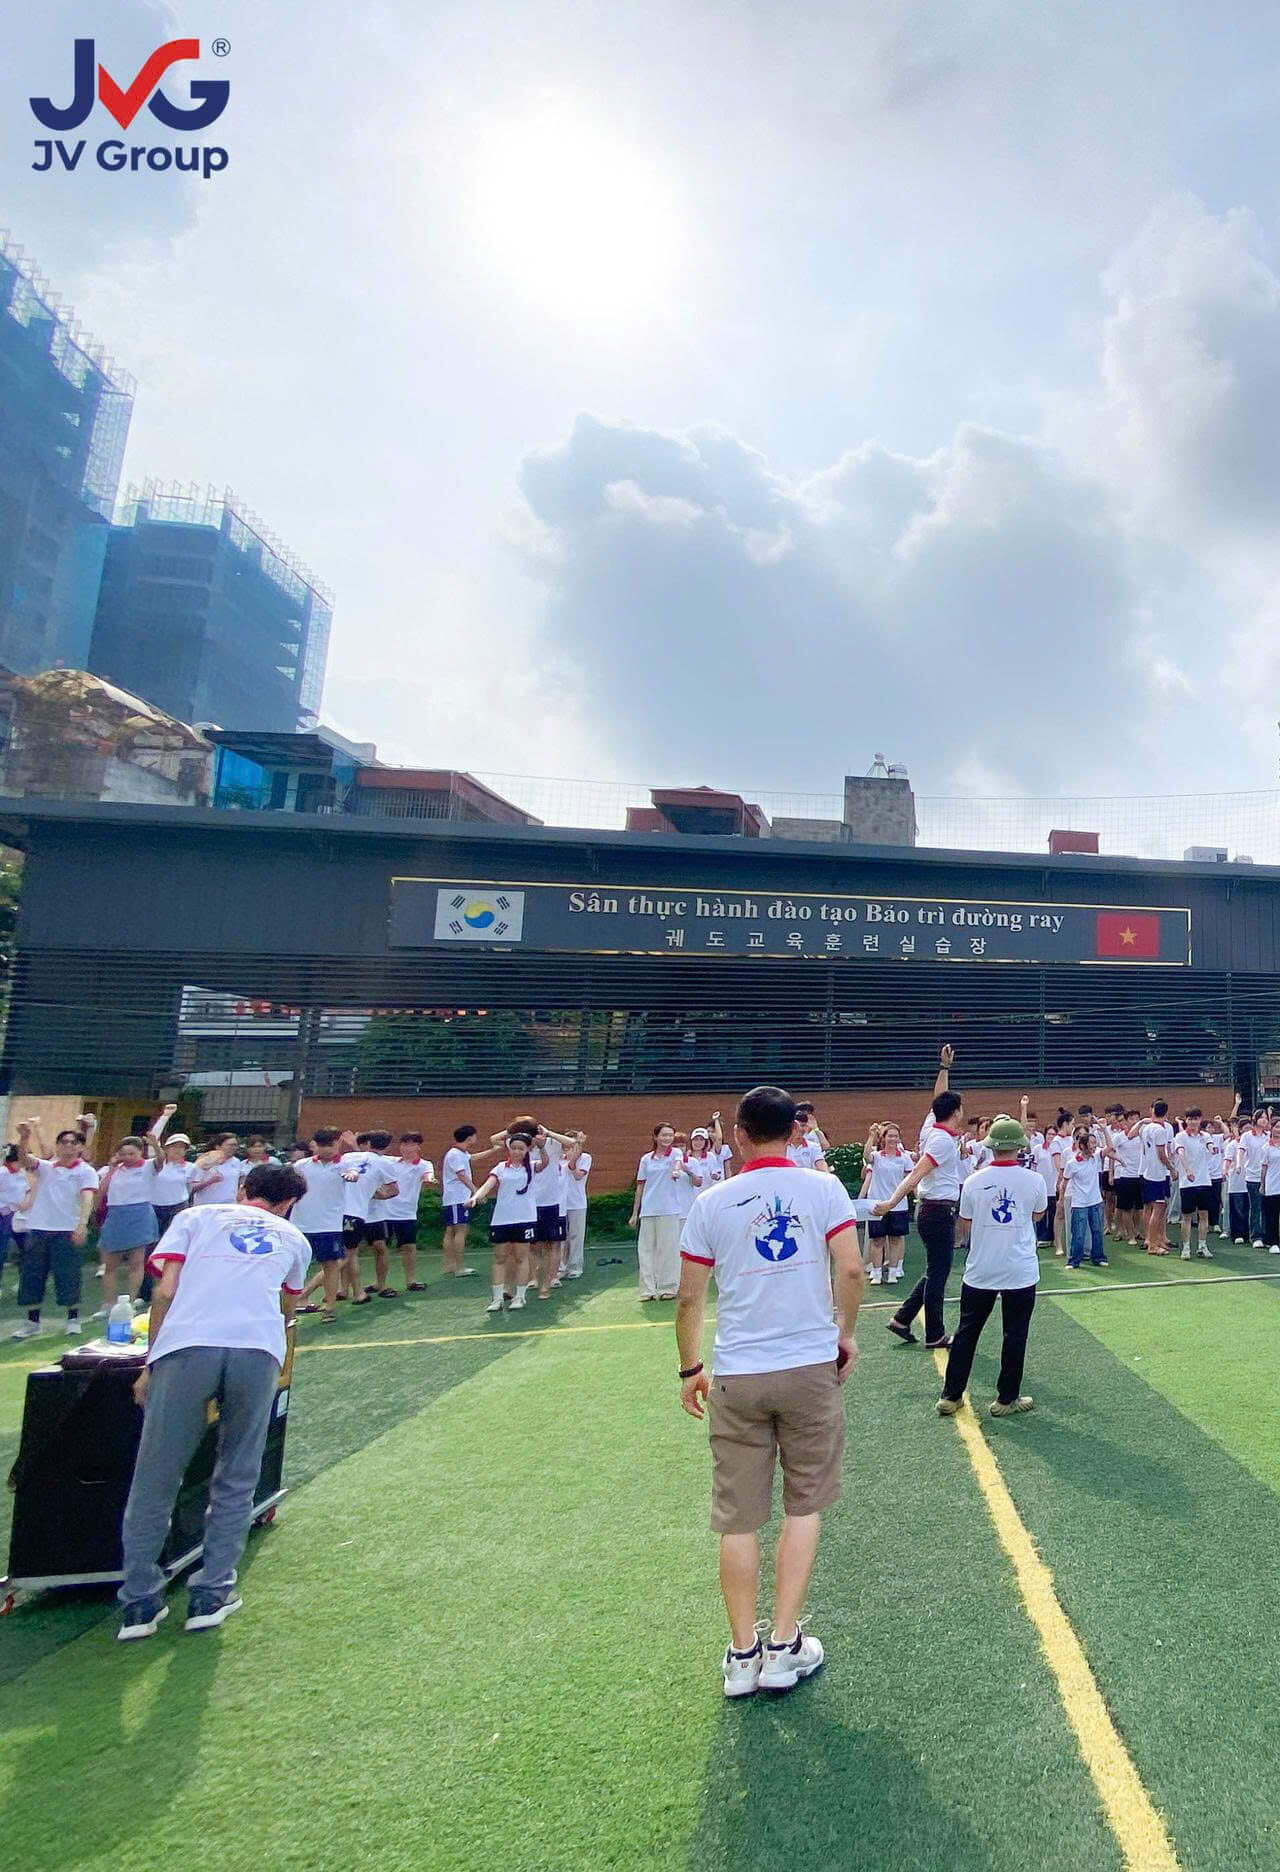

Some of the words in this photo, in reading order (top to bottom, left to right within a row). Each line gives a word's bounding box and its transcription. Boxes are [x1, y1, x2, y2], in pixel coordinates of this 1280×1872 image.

[568, 892, 618, 913] Sân
[628, 895, 688, 920] thực
[695, 897, 758, 918] hành
[767, 900, 812, 920] đào
[820, 903, 857, 926] tạo
[918, 906, 945, 924] trì
[952, 907, 1022, 932] đường
[1029, 914, 1064, 933] ray
